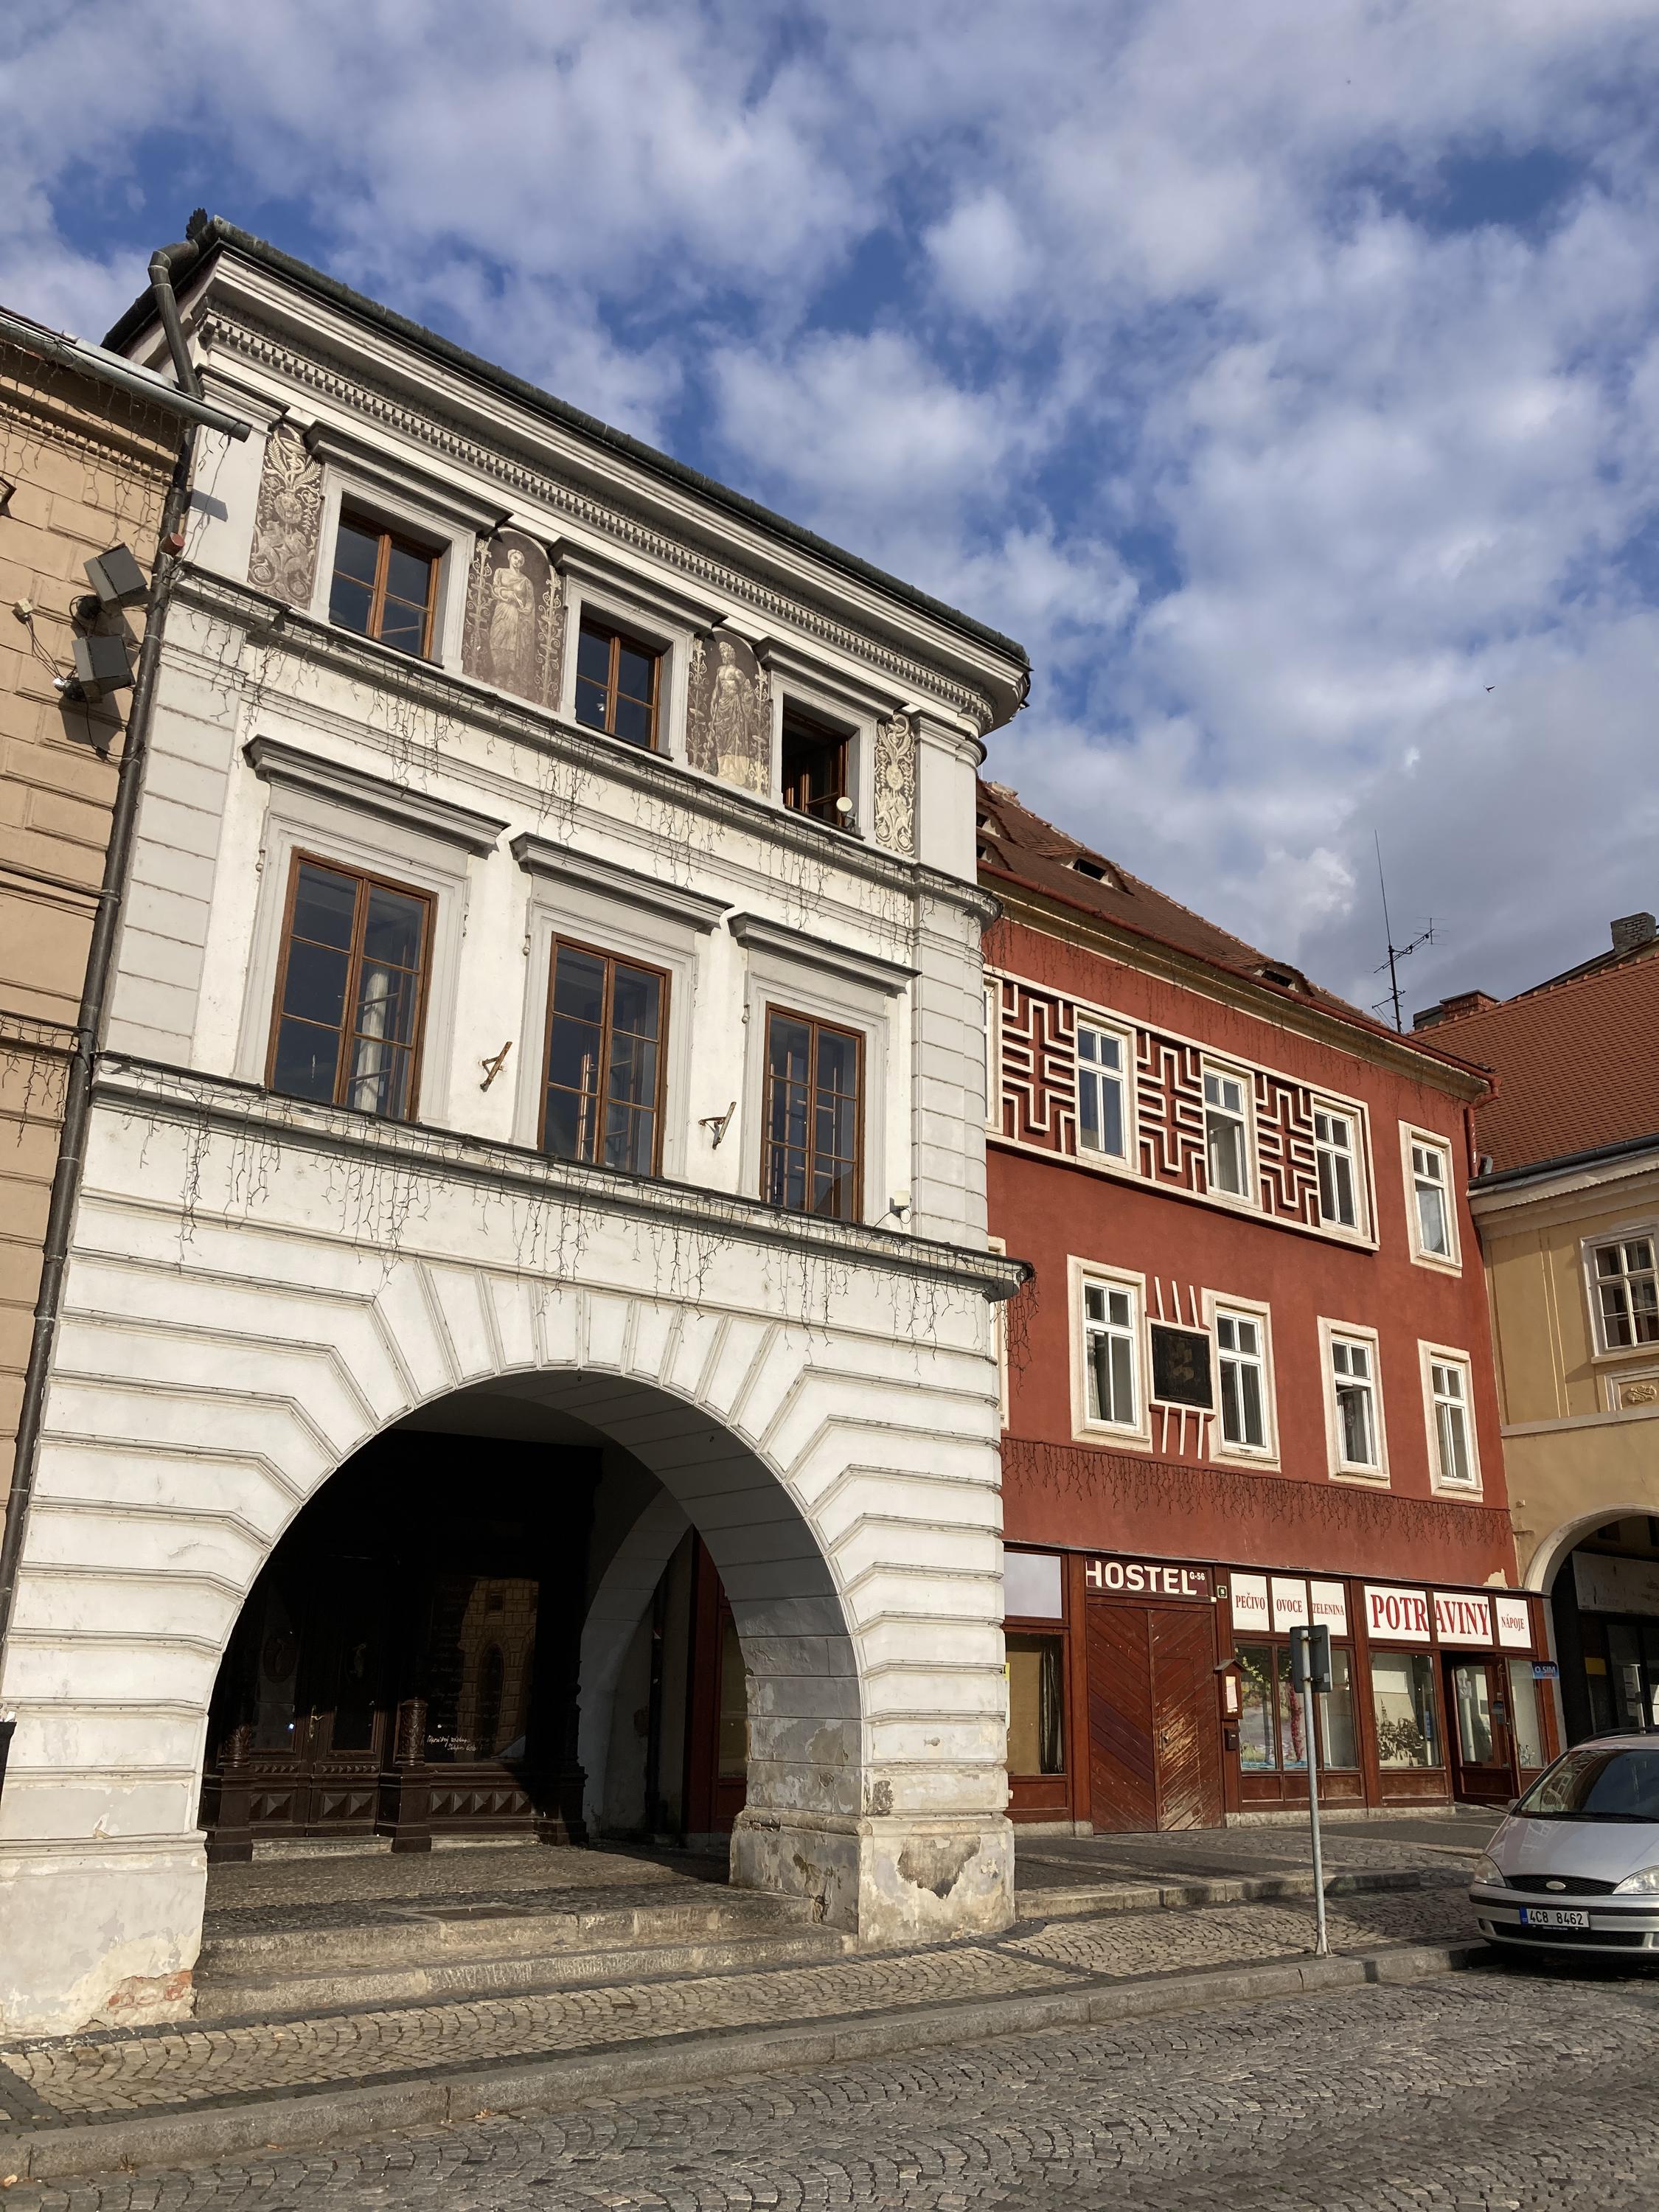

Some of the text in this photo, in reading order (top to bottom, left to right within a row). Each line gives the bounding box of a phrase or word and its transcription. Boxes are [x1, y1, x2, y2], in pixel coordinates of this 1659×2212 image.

[1085, 1560, 1197, 1595] HOSTEL
[1236, 1593, 1265, 1610] PEČIVO
[1276, 1599, 1303, 1613] OVOCE
[1312, 1602, 1345, 1616] ZELENINA
[1500, 1613, 1525, 1631] NÁPOJE
[1530, 1910, 1549, 1923] 4C8
[1557, 1912, 1584, 1925] 8462
